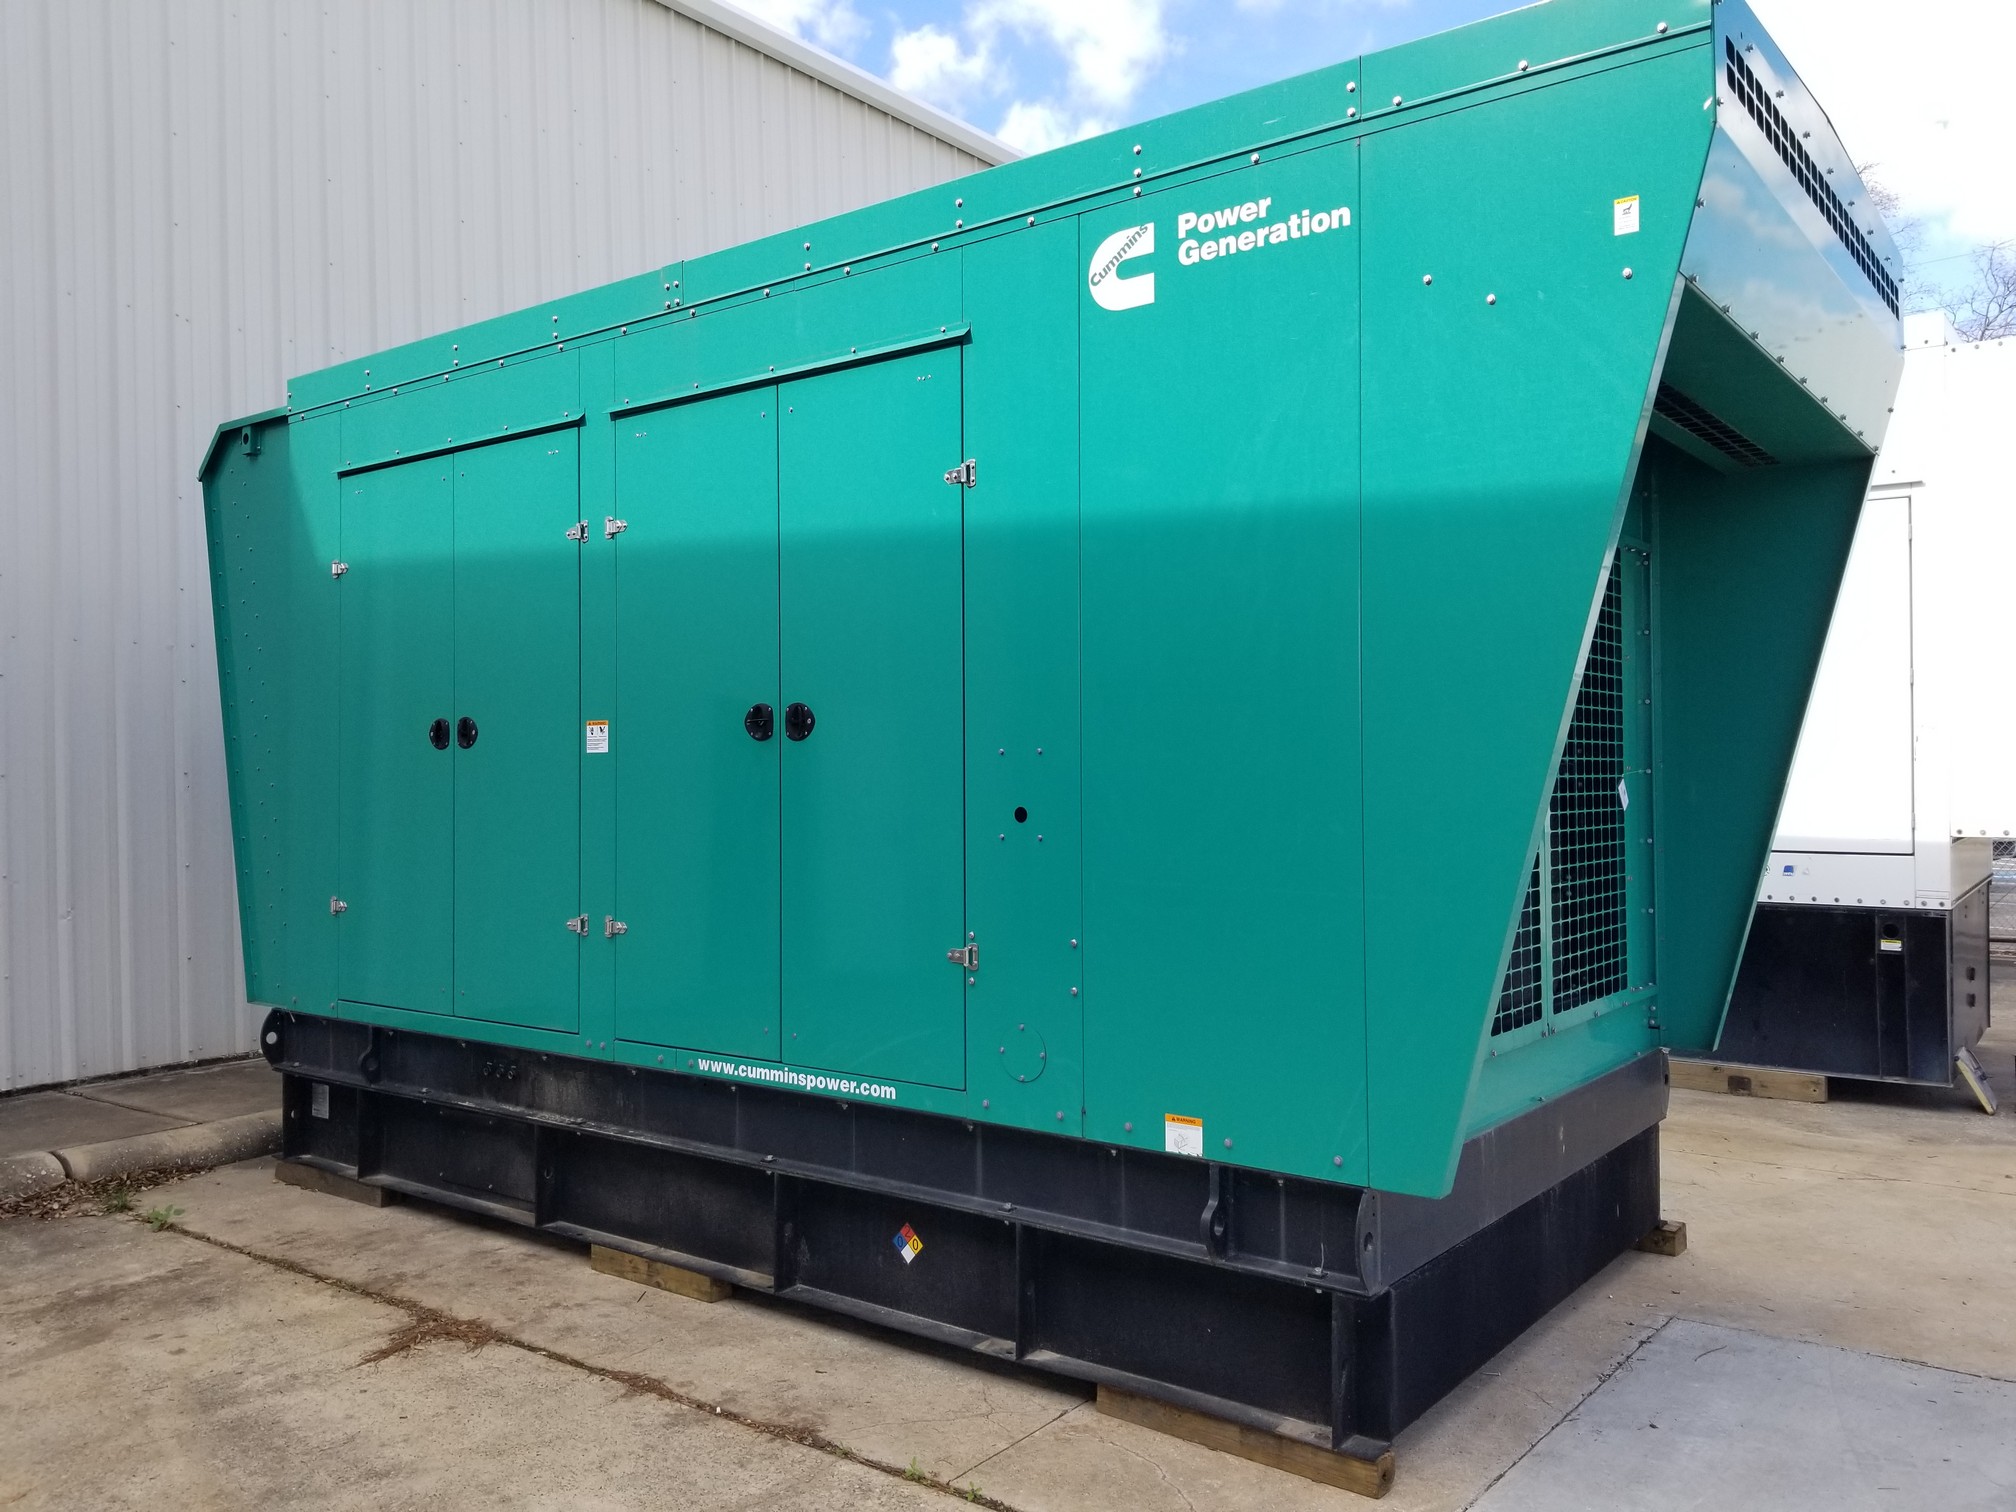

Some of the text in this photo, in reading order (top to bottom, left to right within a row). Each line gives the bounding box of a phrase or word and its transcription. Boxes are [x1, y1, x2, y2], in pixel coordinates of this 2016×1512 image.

[1177, 197, 1272, 239] Power
[1178, 206, 1351, 266] Generation
[1090, 224, 1149, 287] Cummins
[697, 1058, 897, 1100] www.cumminspower.com
[904, 1225, 911, 1238] 2
[912, 1238, 919, 1251] 0
